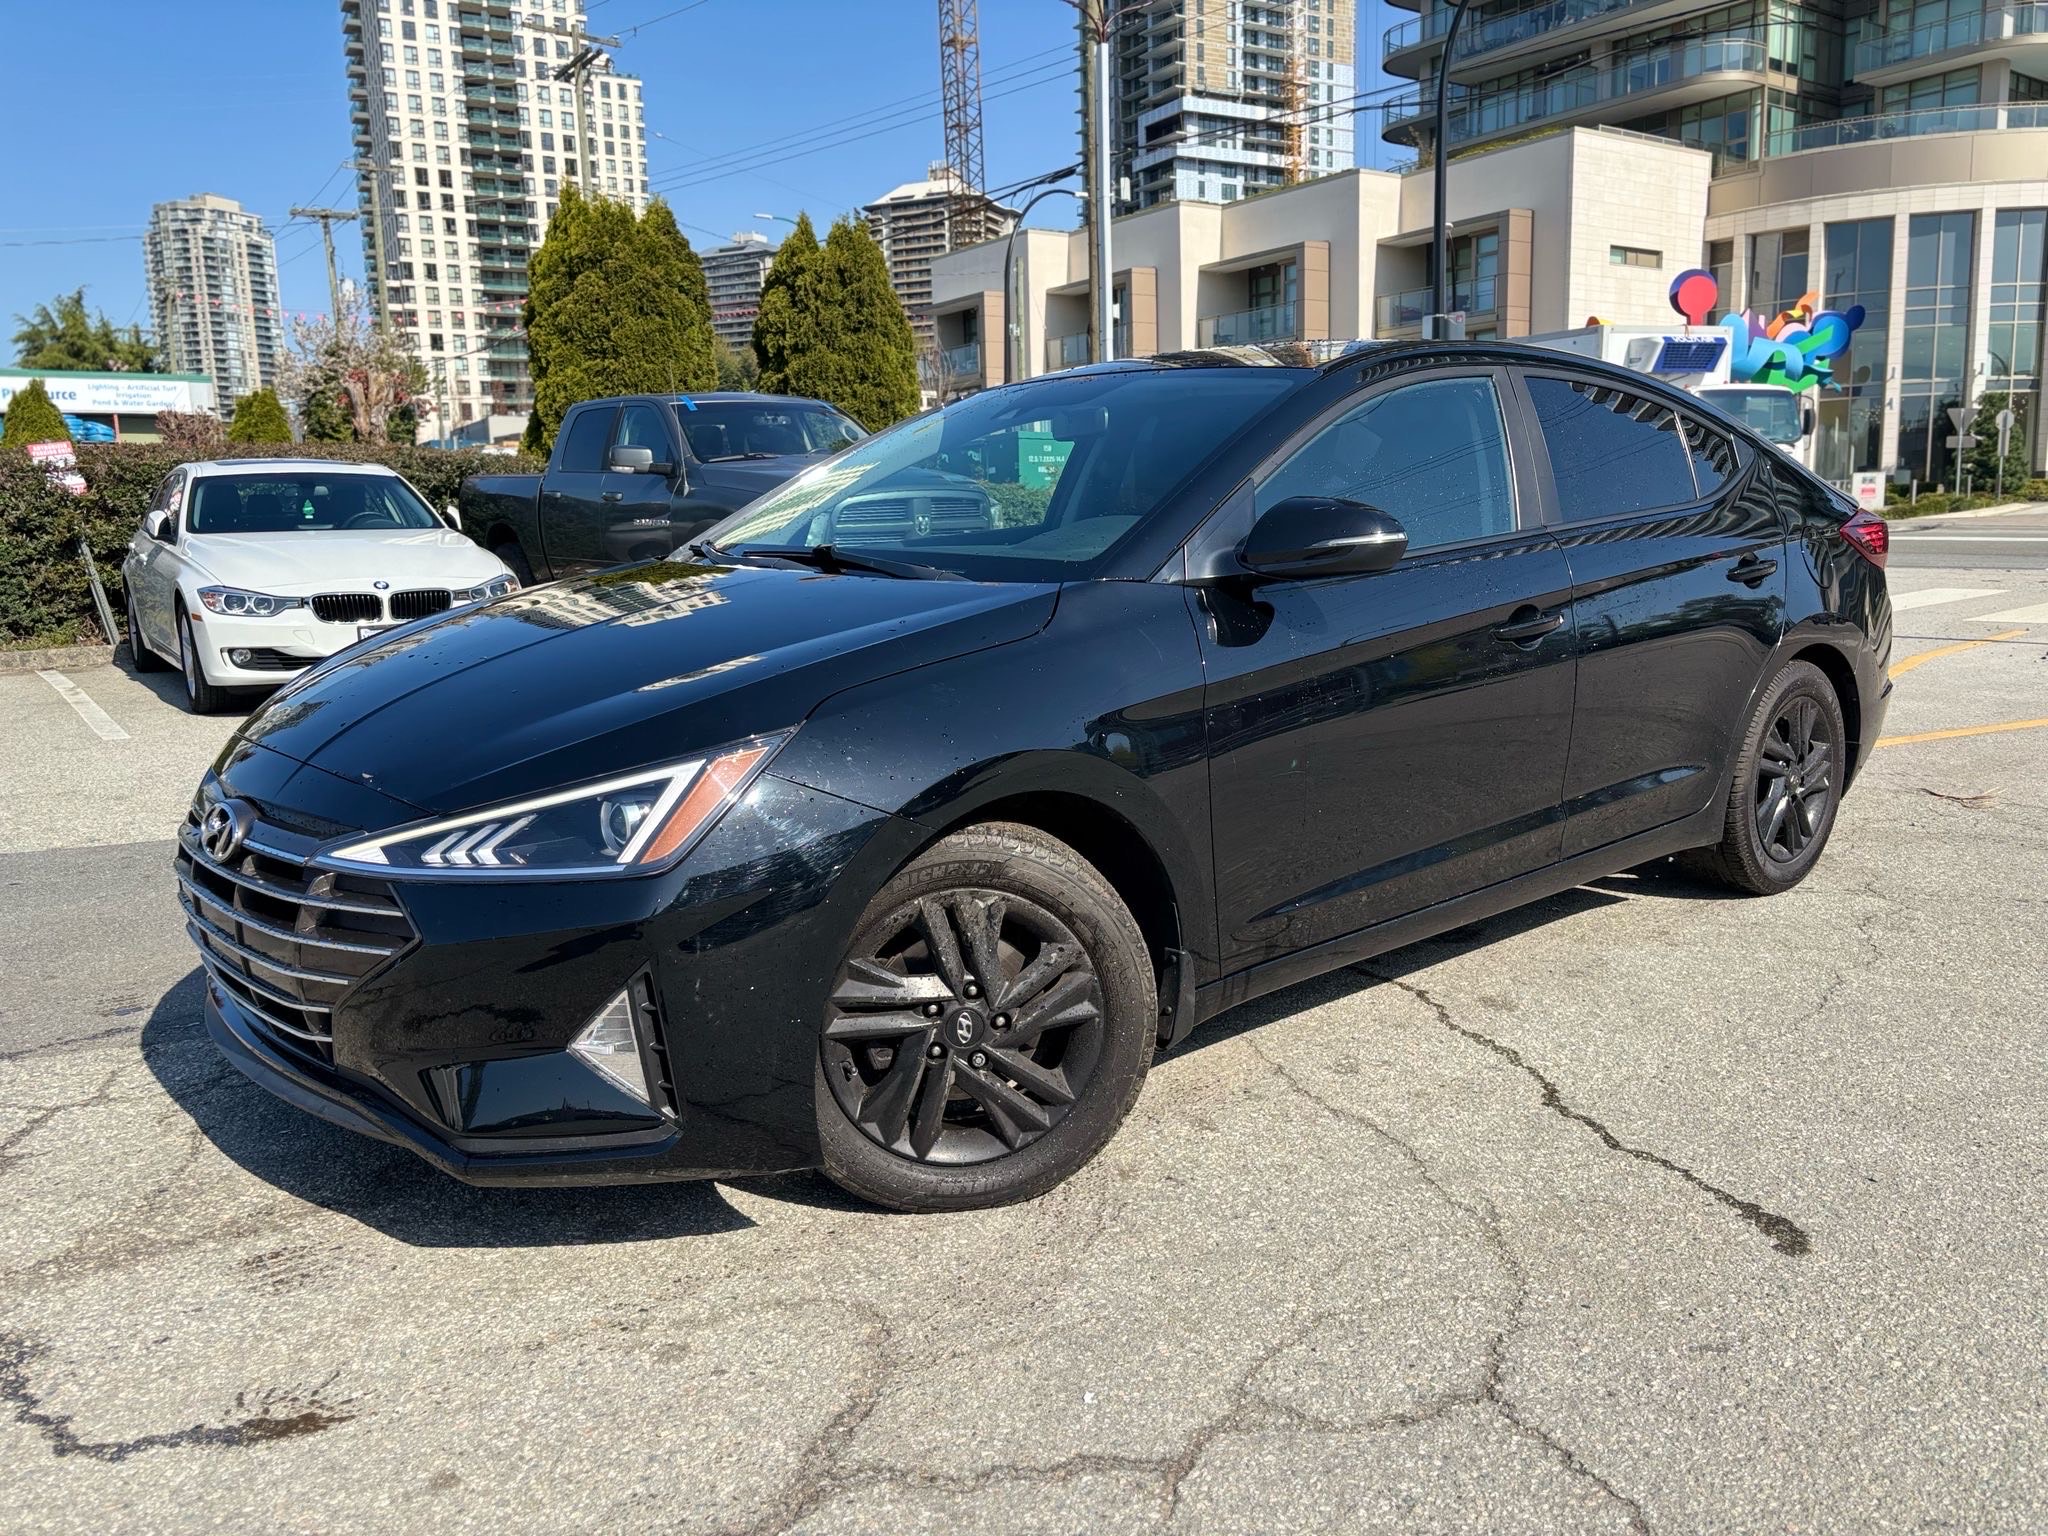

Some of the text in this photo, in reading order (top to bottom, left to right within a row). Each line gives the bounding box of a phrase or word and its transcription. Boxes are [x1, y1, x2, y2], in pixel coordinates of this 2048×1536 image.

[88, 383, 120, 392] Lighting
[162, 384, 177, 392] Turf
[115, 391, 152, 399] Irrigation
